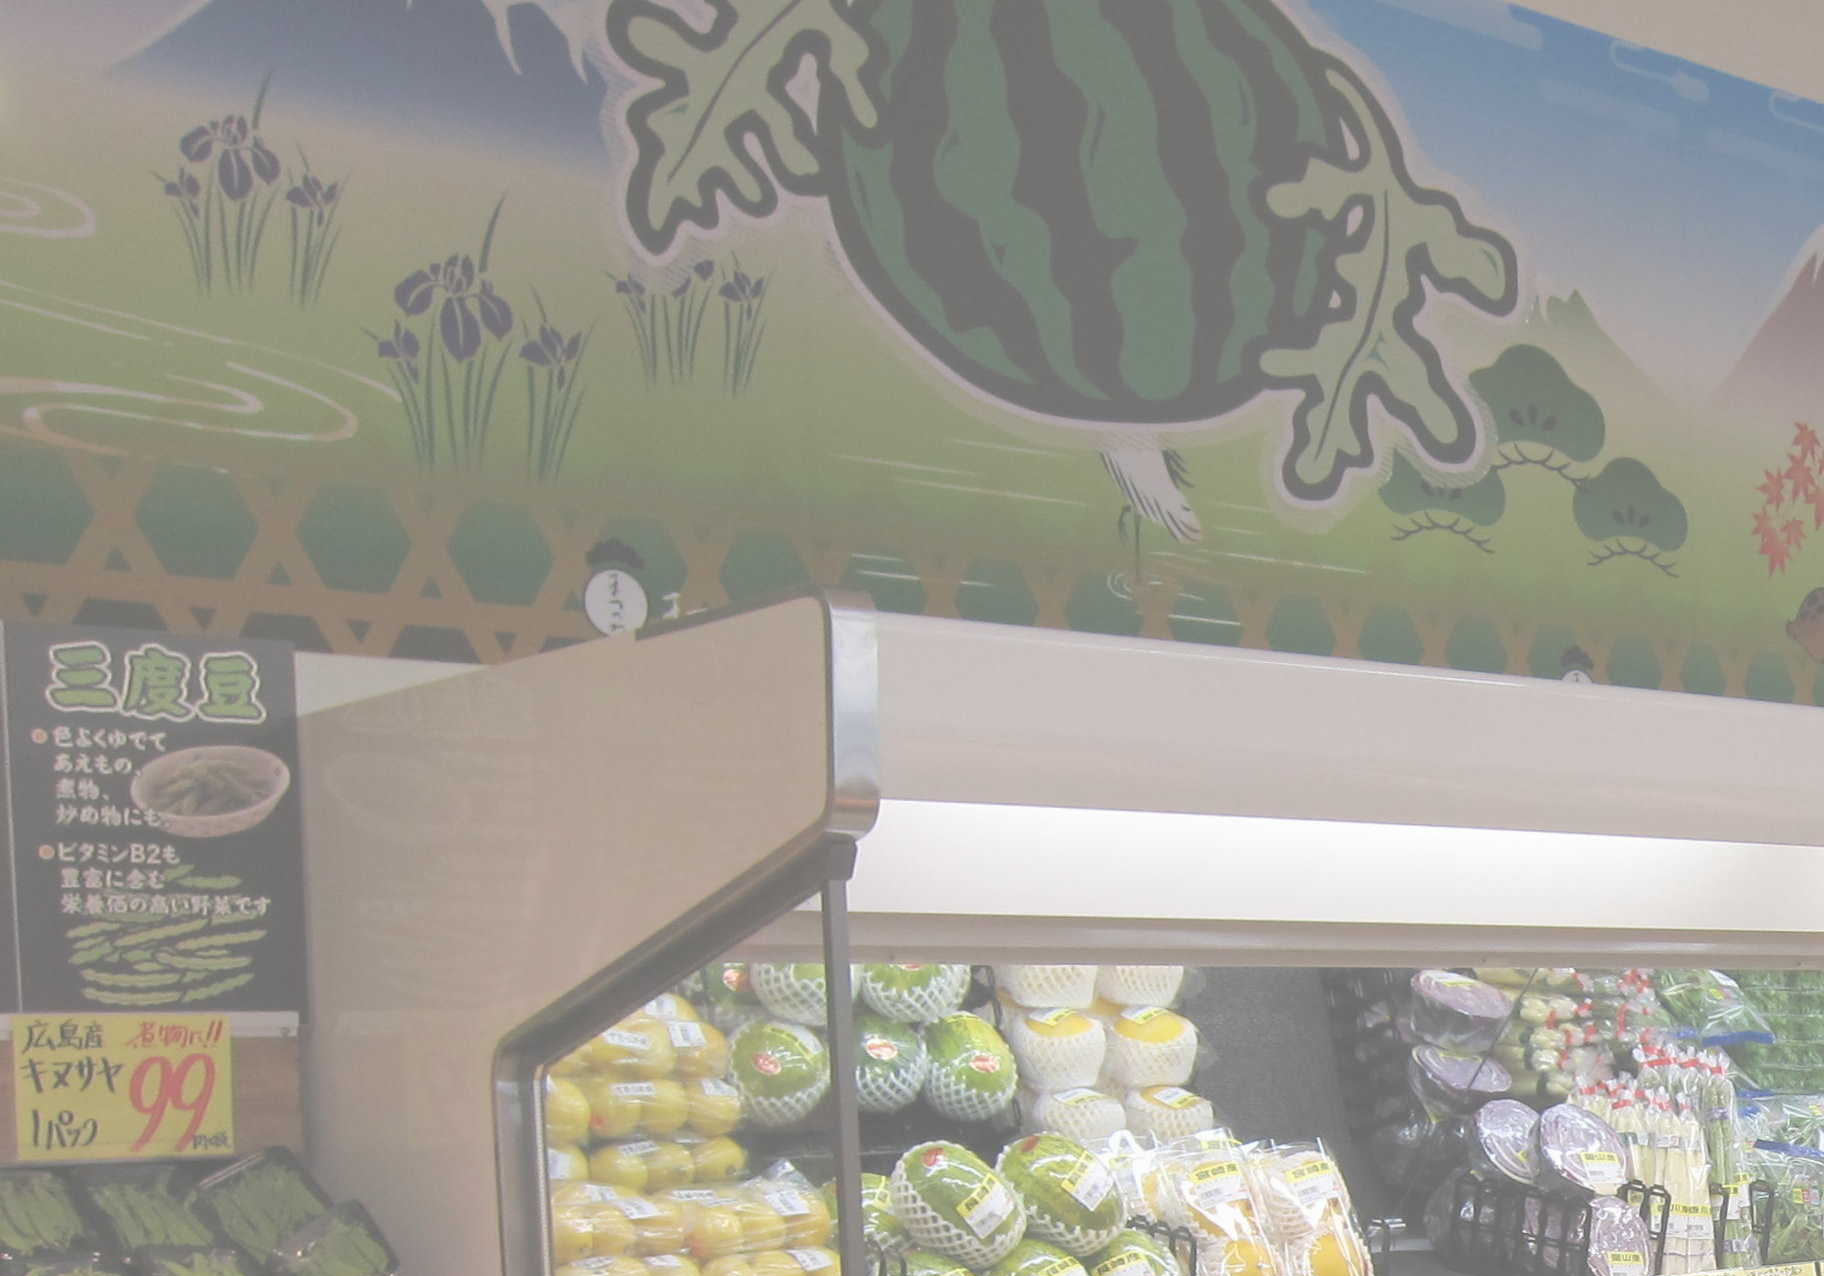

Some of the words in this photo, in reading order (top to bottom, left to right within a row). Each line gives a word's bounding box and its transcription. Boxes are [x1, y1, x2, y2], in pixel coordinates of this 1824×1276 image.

[46, 641, 266, 724] 三度豆
[53, 726, 167, 751] 色よくゆでて
[53, 754, 143, 776] あえもの、
[58, 843, 181, 864] ビタミンB2も
[60, 868, 167, 889] 豊富に含む
[60, 895, 270, 916] 栄養価の高い野菜です
[21, 1019, 104, 1053] 広島産
[20, 1056, 124, 1093] キヌサヤ
[129, 1052, 216, 1152] 99
[32, 1109, 97, 1150] 1パック
